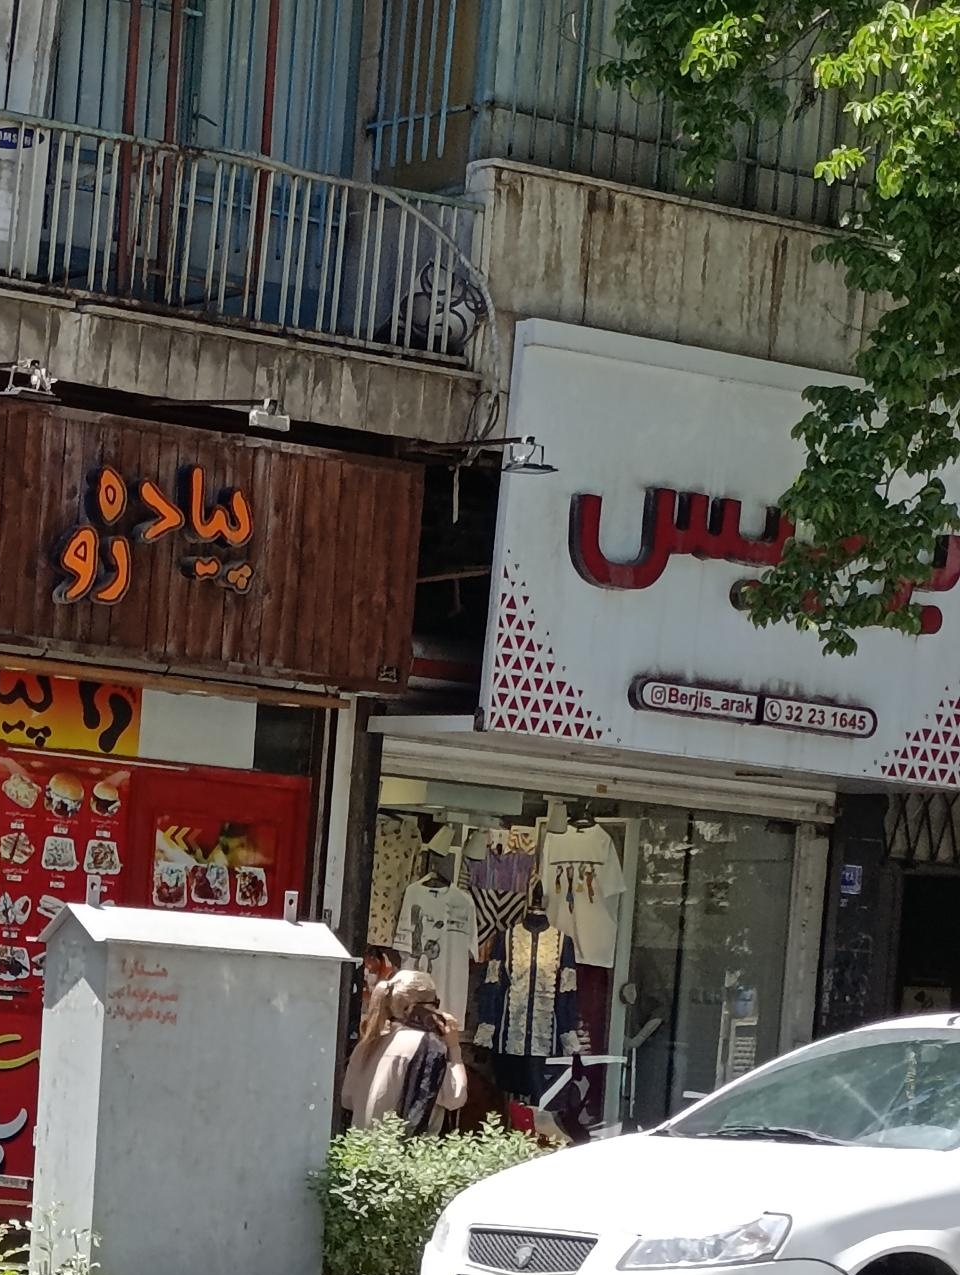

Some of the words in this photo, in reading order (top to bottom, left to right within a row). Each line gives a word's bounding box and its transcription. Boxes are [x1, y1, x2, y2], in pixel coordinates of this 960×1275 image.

[94, 465, 253, 592] پیاده
[58, 522, 132, 604] رو
[667, 687, 753, 715] Berjis_arak
[785, 705, 803, 722] 32
[808, 708, 826, 725] 23
[831, 711, 867, 731] 1645
